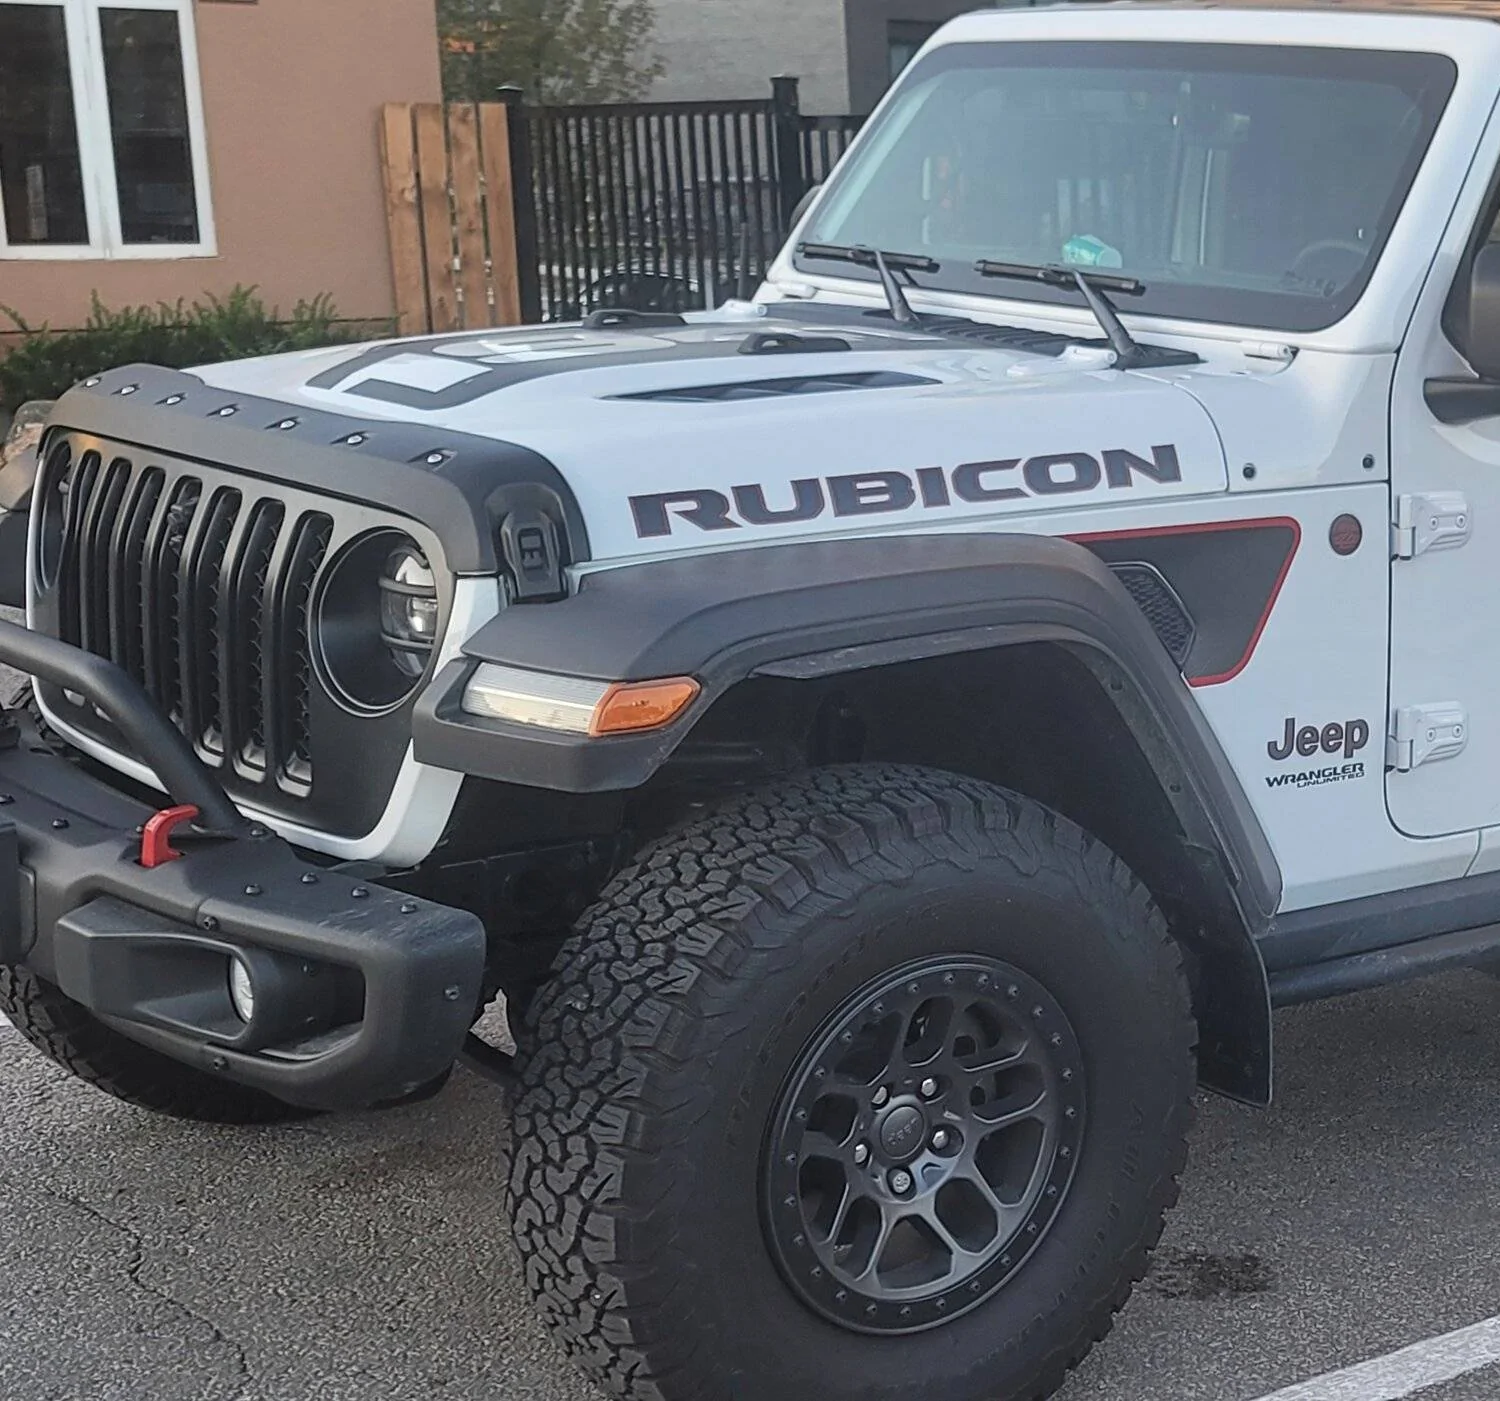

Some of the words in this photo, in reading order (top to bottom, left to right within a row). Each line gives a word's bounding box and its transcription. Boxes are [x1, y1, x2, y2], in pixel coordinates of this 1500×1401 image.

[628, 443, 1182, 538] RUBICON
[1267, 717, 1369, 760] Jeep
[1265, 762, 1364, 787] WRANGLER
[1297, 772, 1364, 788] UNLIMITED
